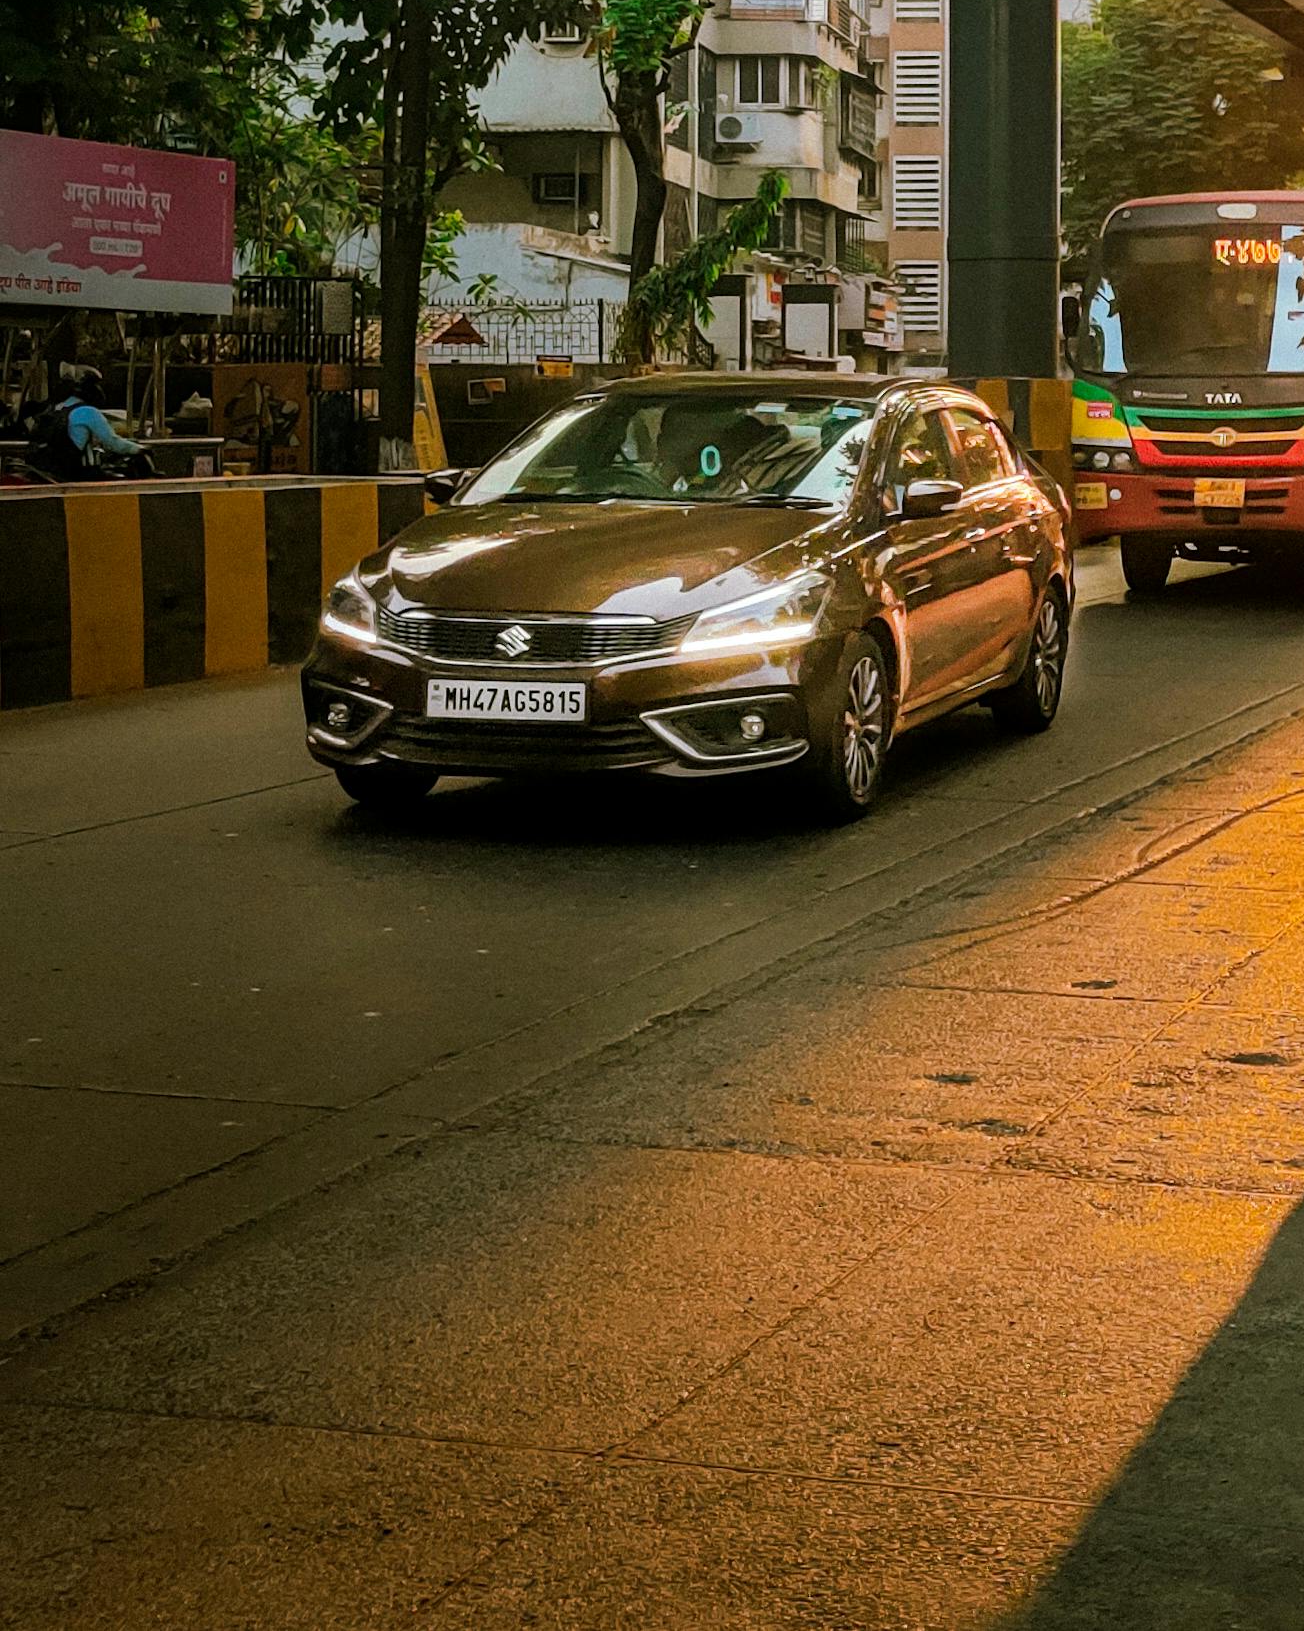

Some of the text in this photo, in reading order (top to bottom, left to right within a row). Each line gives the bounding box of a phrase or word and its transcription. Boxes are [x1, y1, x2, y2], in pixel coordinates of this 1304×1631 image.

[62, 181, 101, 212] अमूल
[151, 191, 172, 221] दूध
[1204, 392, 1243, 405] TATA
[445, 686, 582, 715] MH47AG5815
